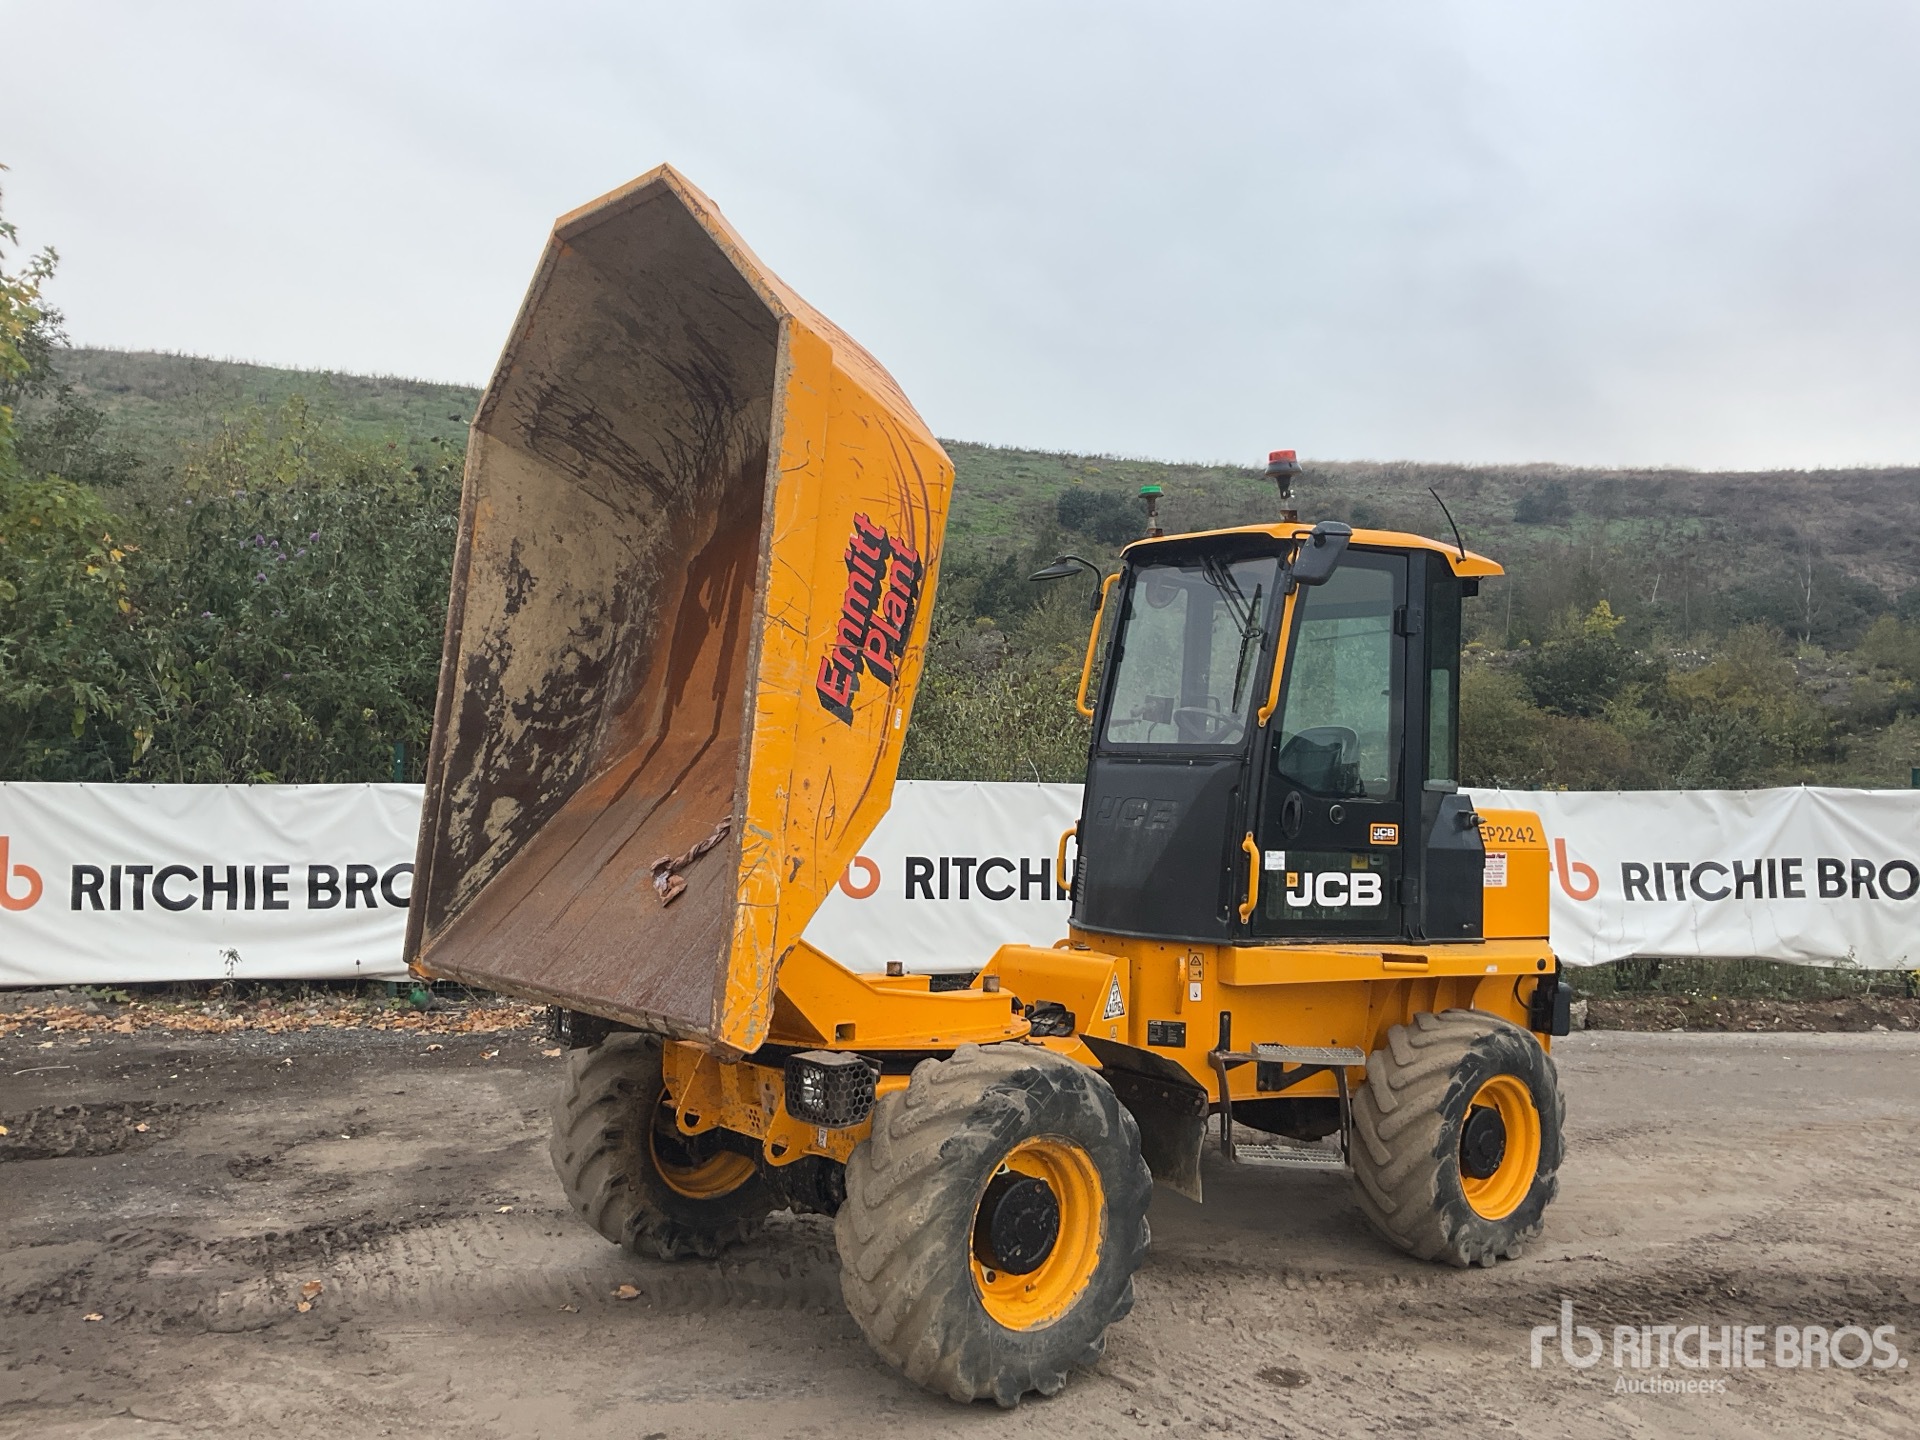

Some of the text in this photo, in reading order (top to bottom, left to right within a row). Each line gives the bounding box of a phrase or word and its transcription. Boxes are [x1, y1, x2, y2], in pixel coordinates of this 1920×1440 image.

[816, 512, 891, 726] Emmitt
[862, 536, 923, 687] Plant
[1373, 828, 1395, 836] JCB
[1479, 826, 1536, 843] EP2242
[71, 864, 290, 911] RITCHIE
[905, 856, 1077, 901] RITCHI
[1286, 872, 1382, 907] JCB
[1621, 857, 1807, 902] RITCHIE
